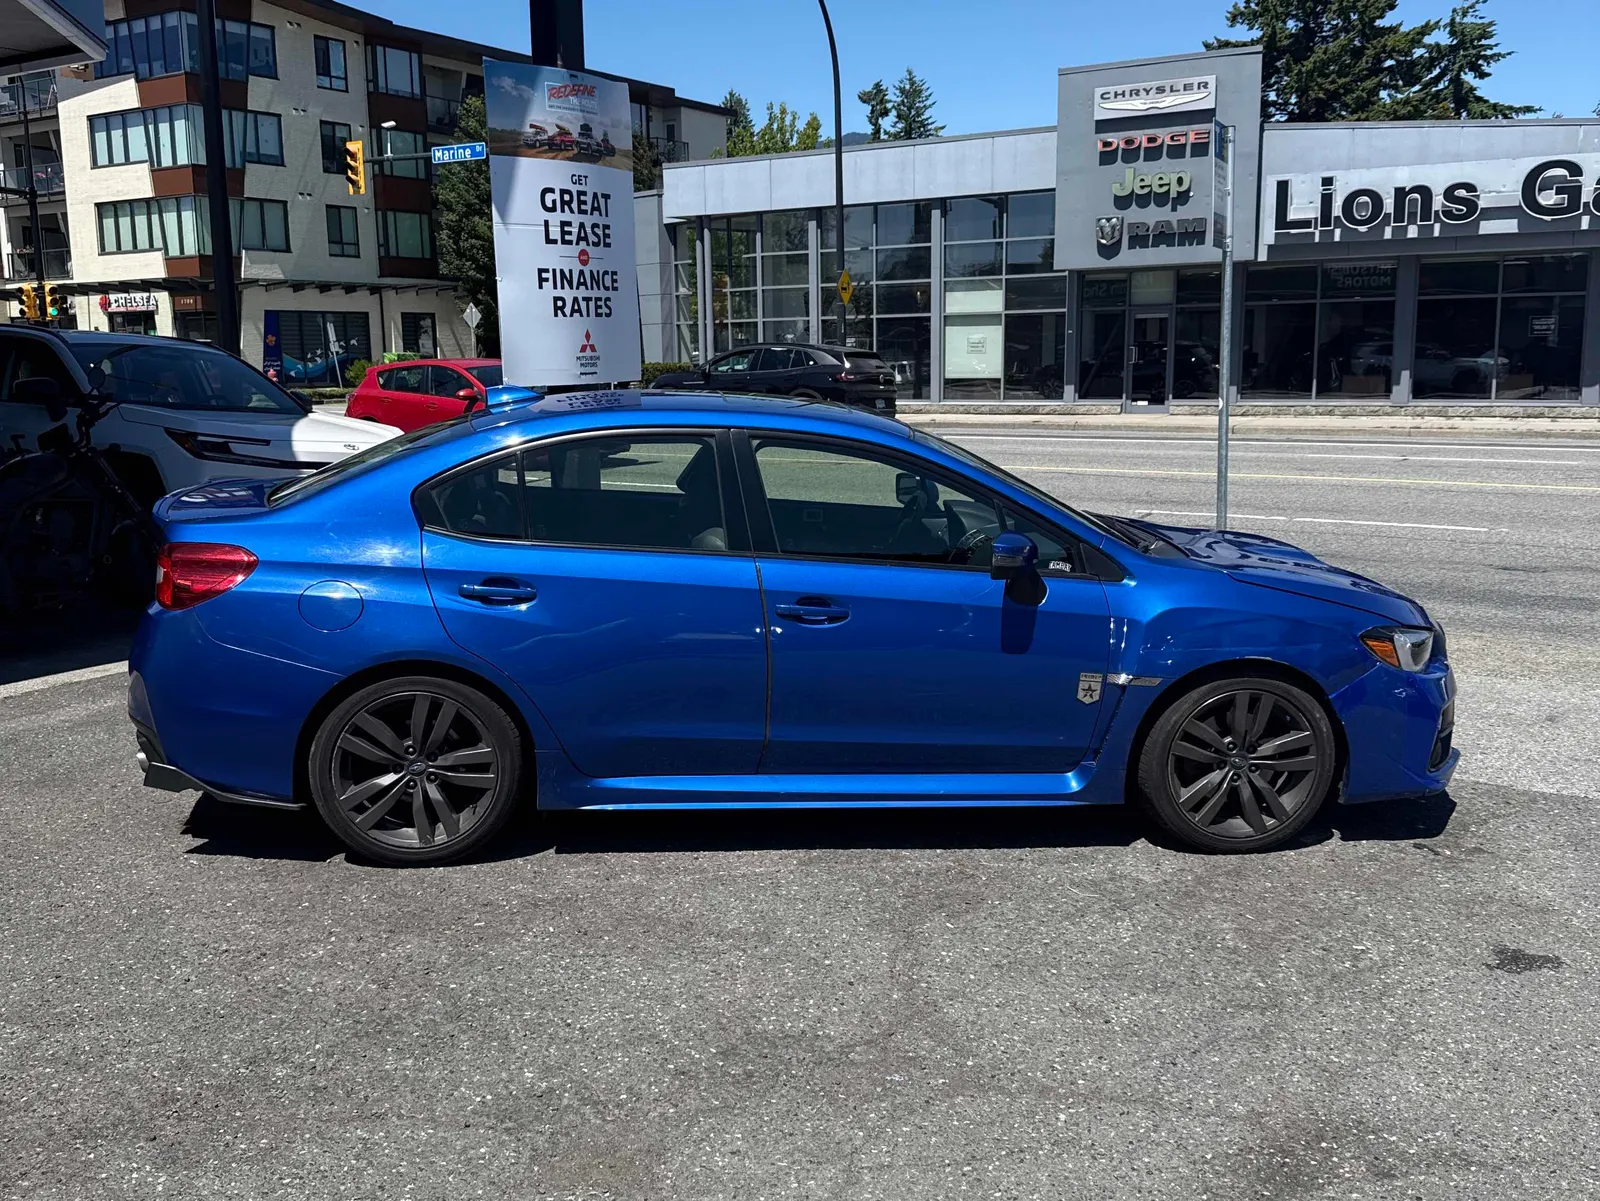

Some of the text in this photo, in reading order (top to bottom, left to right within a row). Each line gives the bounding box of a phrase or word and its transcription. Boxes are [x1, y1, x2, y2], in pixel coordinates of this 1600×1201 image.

[548, 83, 596, 101] REDEFINE
[1100, 81, 1209, 100] CHRYSLER
[1097, 129, 1210, 152] DODGE
[435, 146, 471, 160] Marine
[570, 173, 588, 186] GET
[1111, 167, 1191, 198] Jeep
[540, 186, 611, 218] GREAT
[1274, 176, 1481, 233] Lions
[1519, 159, 1600, 219] G
[543, 219, 612, 248] LEASE
[1126, 218, 1207, 236] RAM
[537, 267, 619, 292] FINANCE
[112, 295, 157, 307] CHELSEA
[552, 296, 613, 318] RATES
